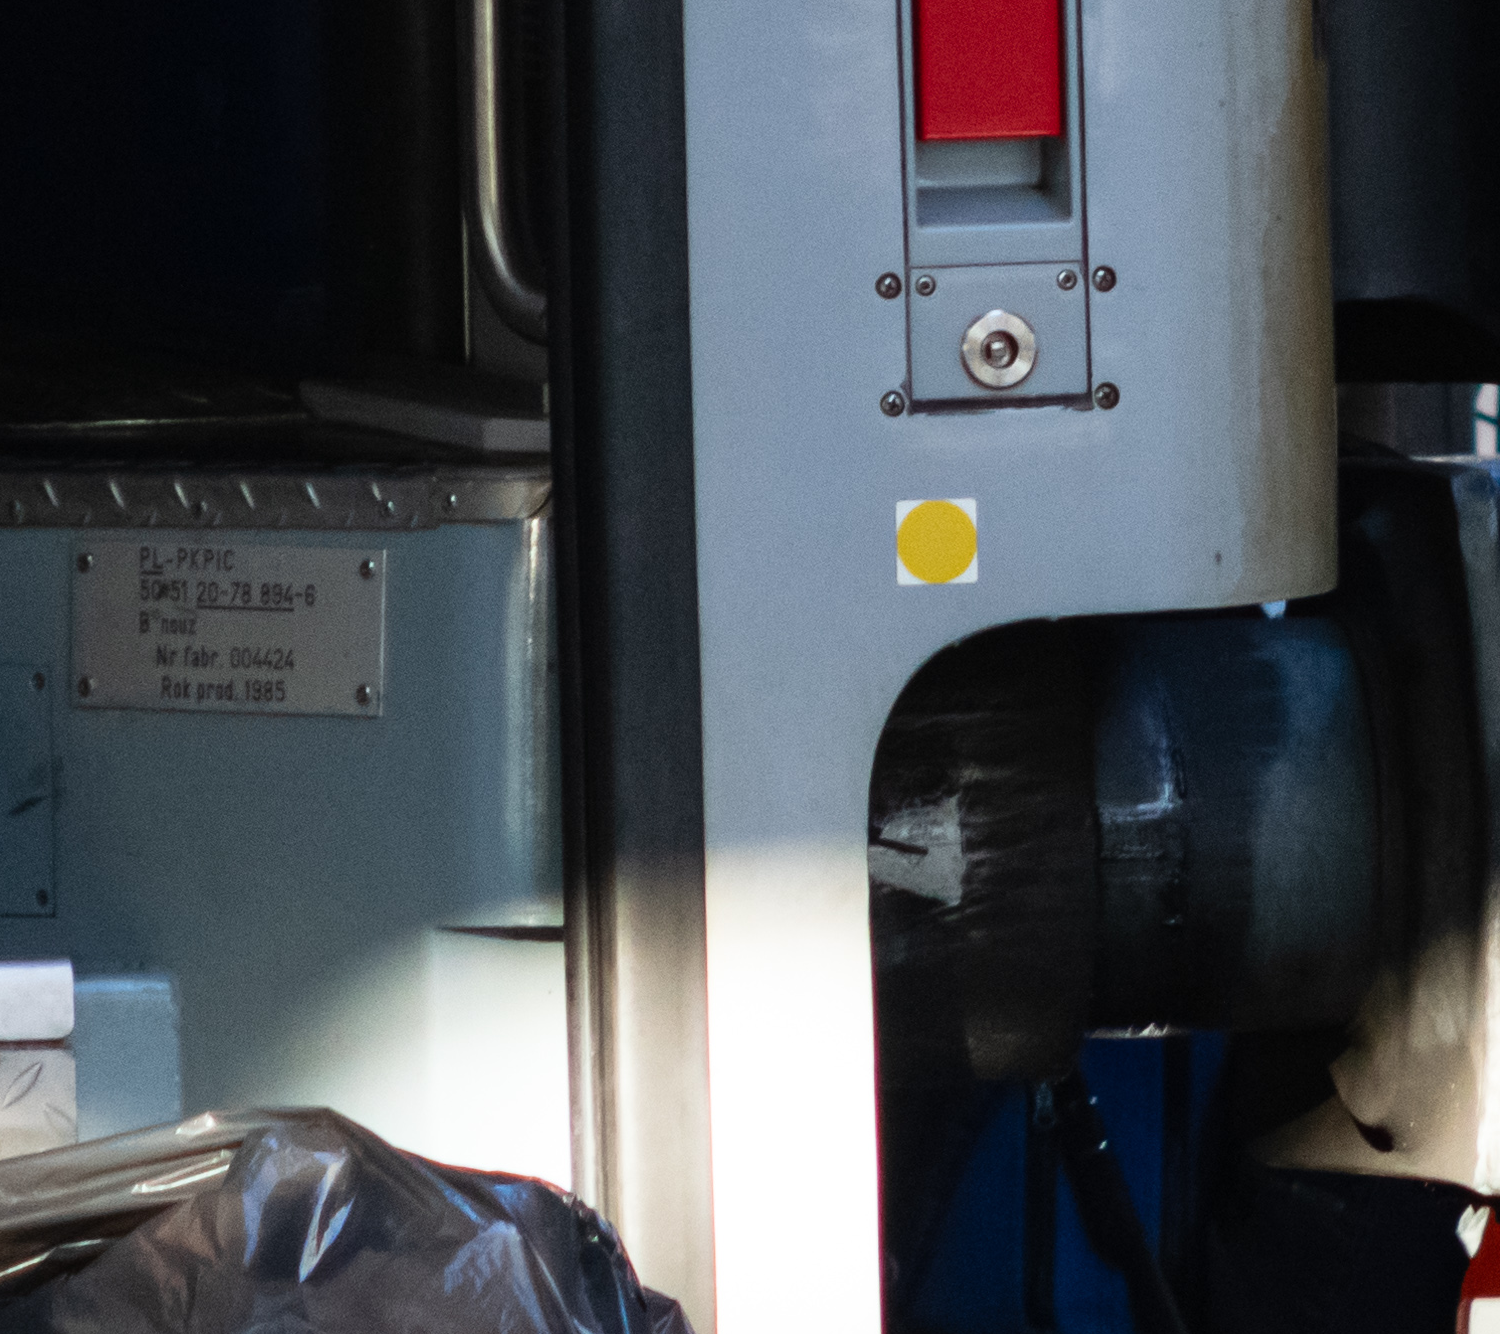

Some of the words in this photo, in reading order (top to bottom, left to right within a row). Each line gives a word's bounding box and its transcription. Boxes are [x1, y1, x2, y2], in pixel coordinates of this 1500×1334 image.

[139, 546, 235, 573] PL-PKPIC
[196, 581, 251, 606] 20-78
[260, 583, 317, 607] 894-6
[156, 646, 176, 666] Nr
[161, 675, 191, 699] Rok
[244, 679, 287, 702] 1985
